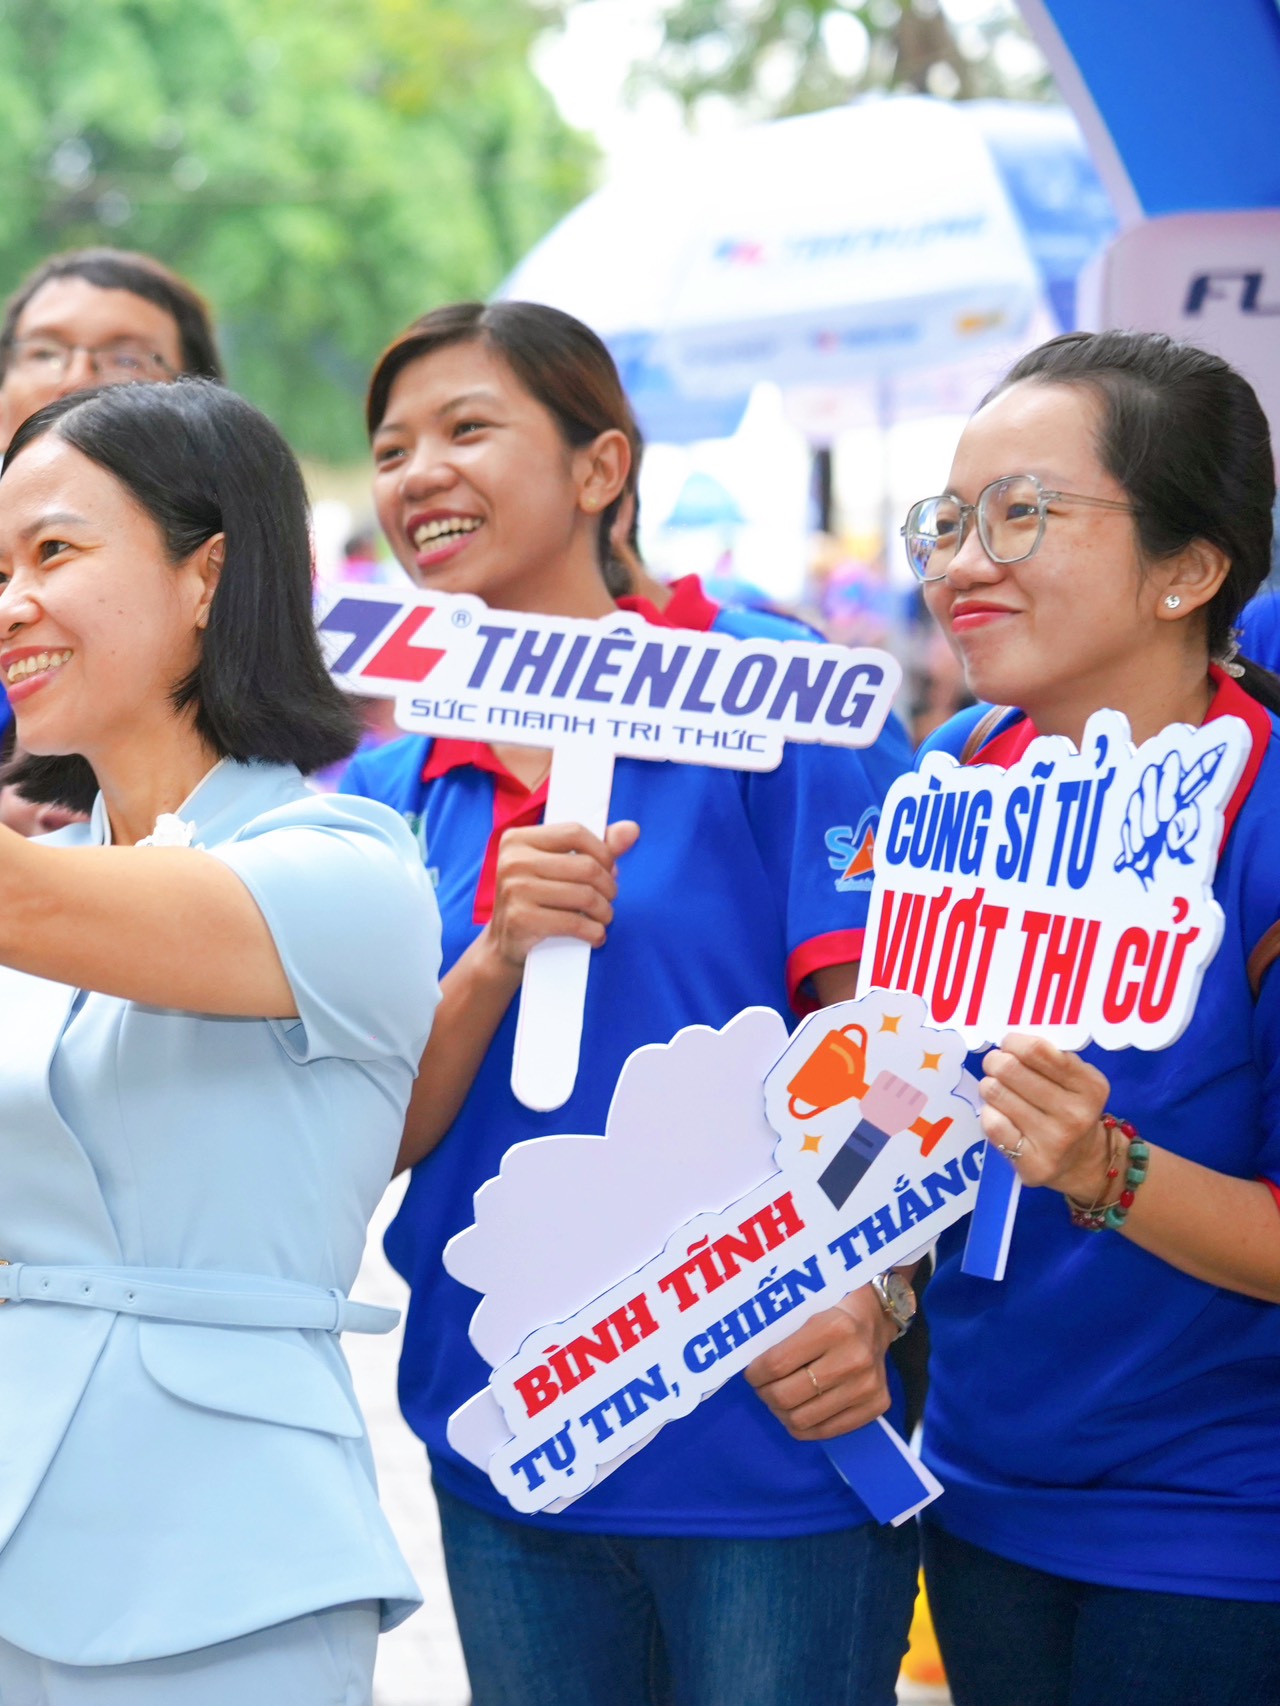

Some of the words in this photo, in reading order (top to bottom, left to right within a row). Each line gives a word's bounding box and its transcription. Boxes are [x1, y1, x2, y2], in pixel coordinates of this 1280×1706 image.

[410, 698, 478, 723] SỨC
[487, 707, 596, 735] MẠNH
[606, 718, 661, 742] TRI
[672, 726, 767, 753] THỨC
[467, 627, 884, 729] THIÊNLONG
[885, 774, 993, 877] CÙNG
[995, 760, 1056, 883] SĨ
[1046, 734, 1117, 890] TỬ
[1007, 910, 1102, 1025] THI
[1102, 896, 1201, 1025] CỬ
[513, 1293, 660, 1419] BÌNH
[657, 1190, 807, 1314] TĨNH
[511, 1419, 577, 1493] TỰ
[580, 1362, 681, 1445] TIN,
[682, 1265, 827, 1374] CHIẾN
